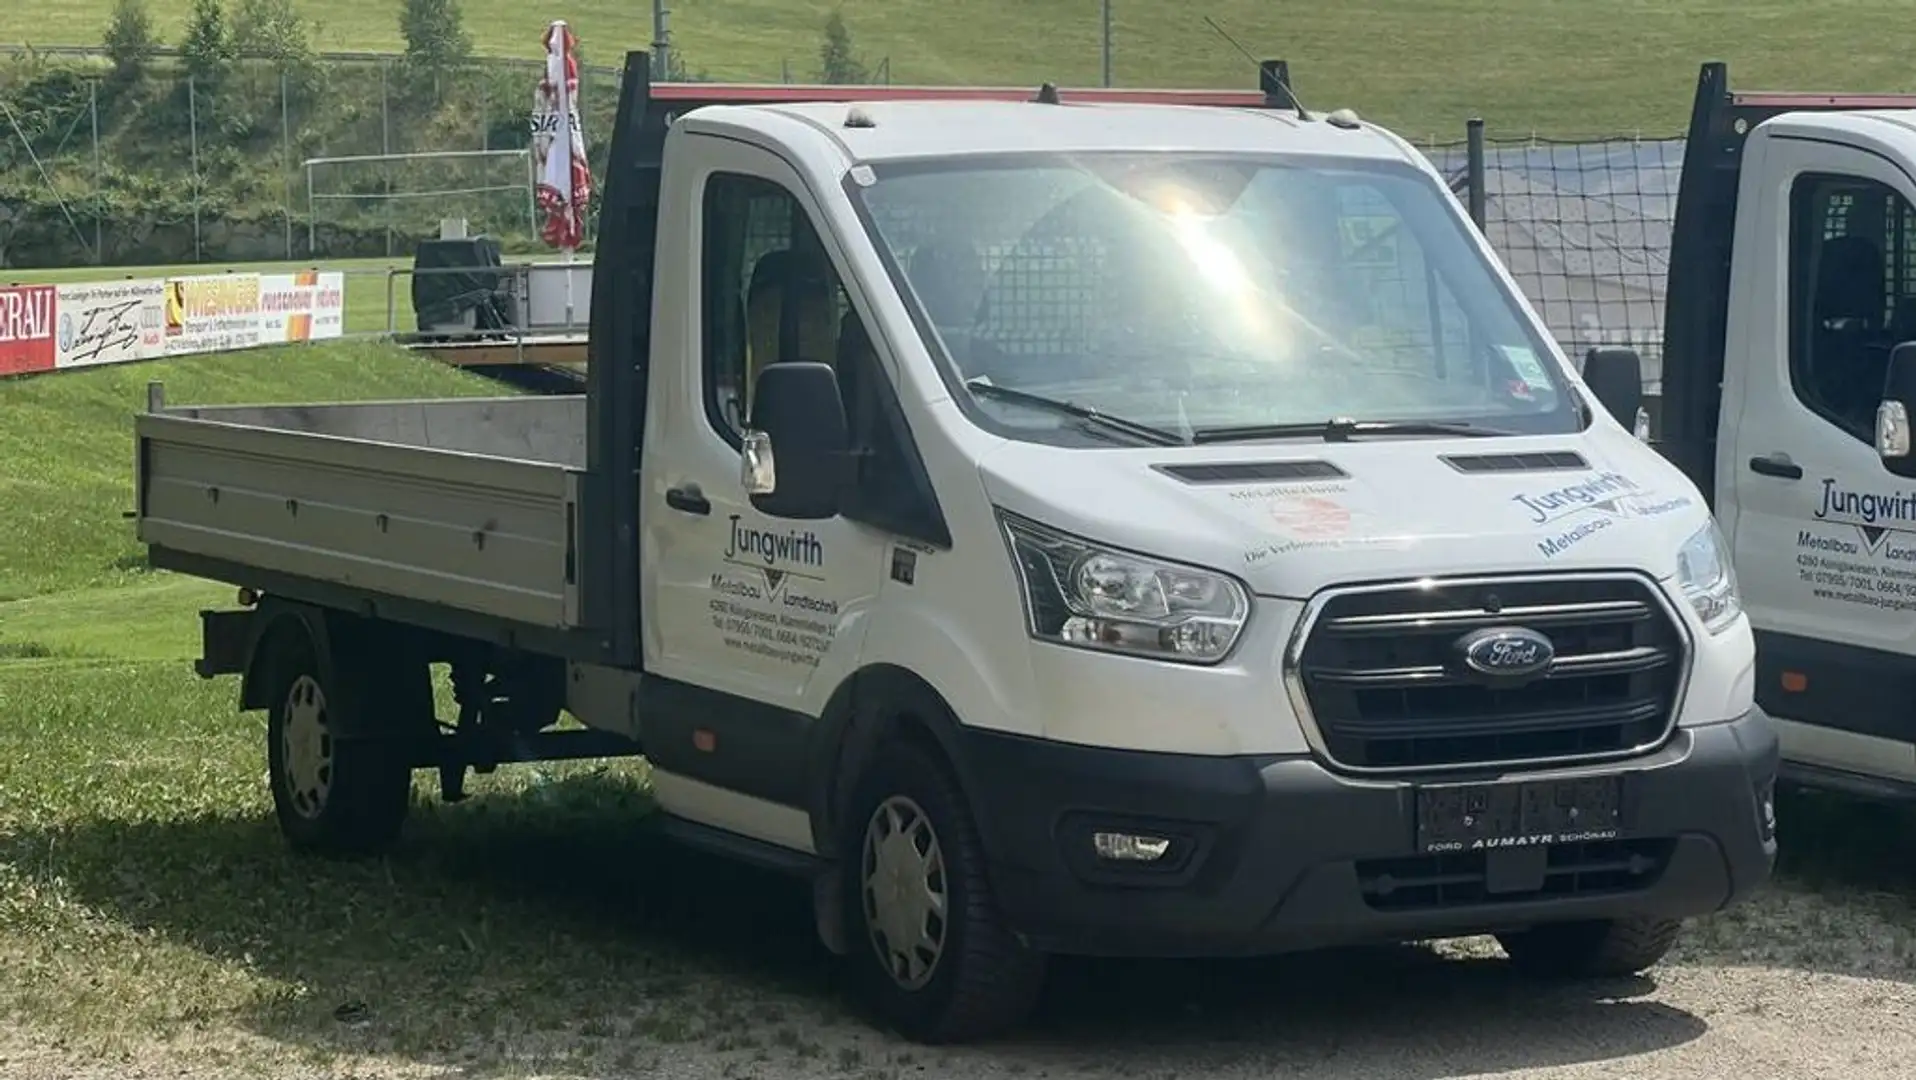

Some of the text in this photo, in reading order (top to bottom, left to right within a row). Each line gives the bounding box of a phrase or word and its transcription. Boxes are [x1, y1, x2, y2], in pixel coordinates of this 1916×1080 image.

[724, 514, 824, 566] Jungwirth
[1797, 530, 1858, 555] Metallbau
[711, 573, 761, 599] Metallbau
[1489, 640, 1537, 665] Ford
[1427, 830, 1617, 852] FORD AUMAYR SCHÖNAU
